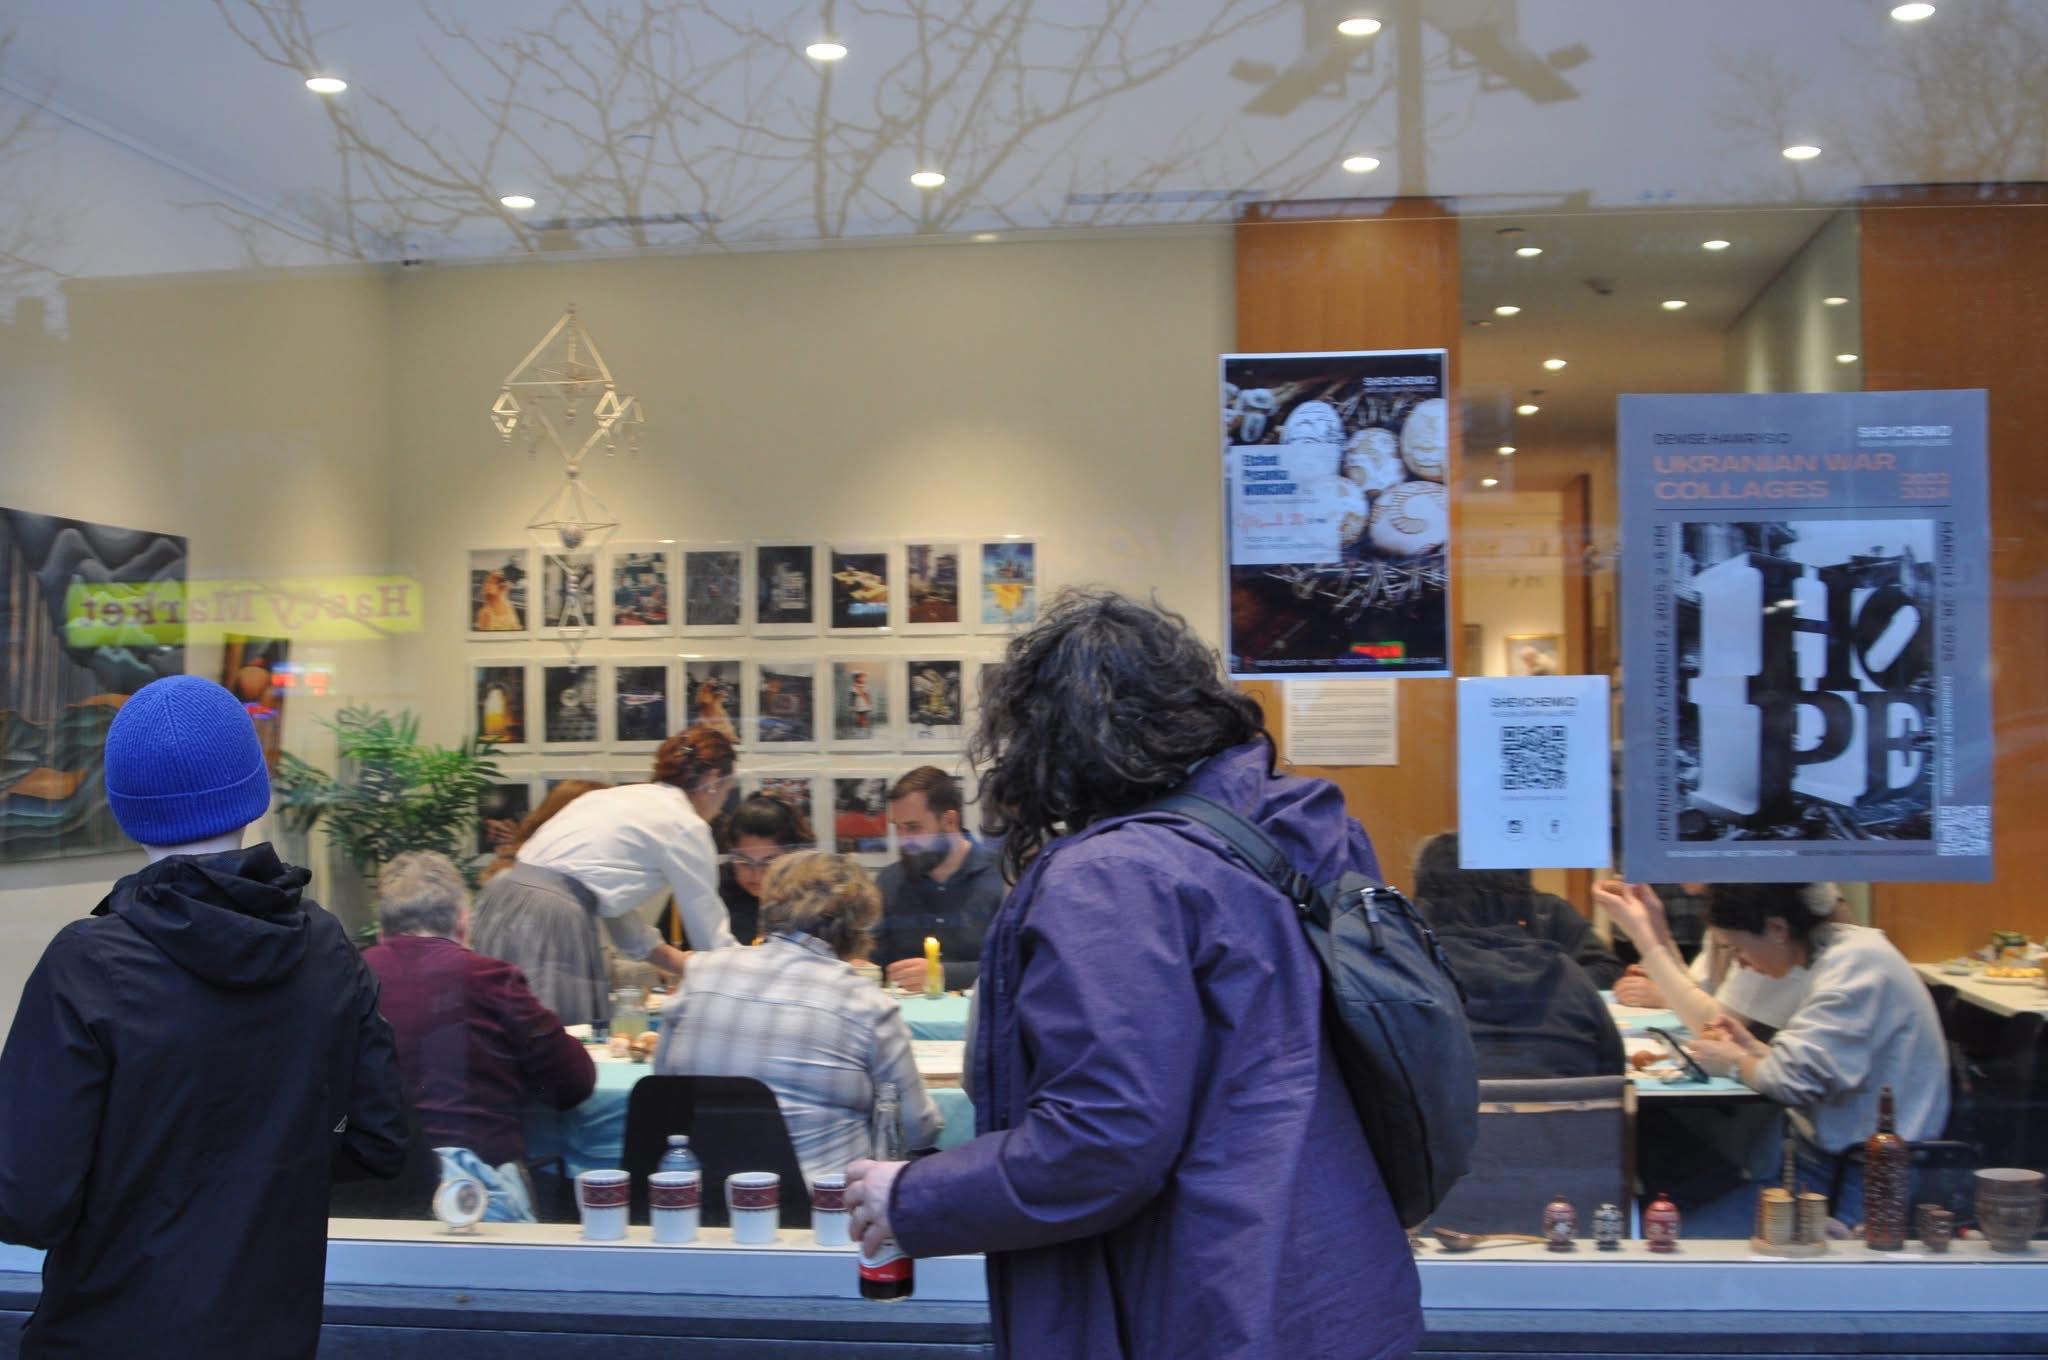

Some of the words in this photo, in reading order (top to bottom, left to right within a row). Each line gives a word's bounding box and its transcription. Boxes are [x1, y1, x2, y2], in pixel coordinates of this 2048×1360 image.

[1654, 454, 1819, 474] UKRANIAN
[1825, 453, 1896, 472] WAR
[1655, 480, 1831, 501] COLLAGES
